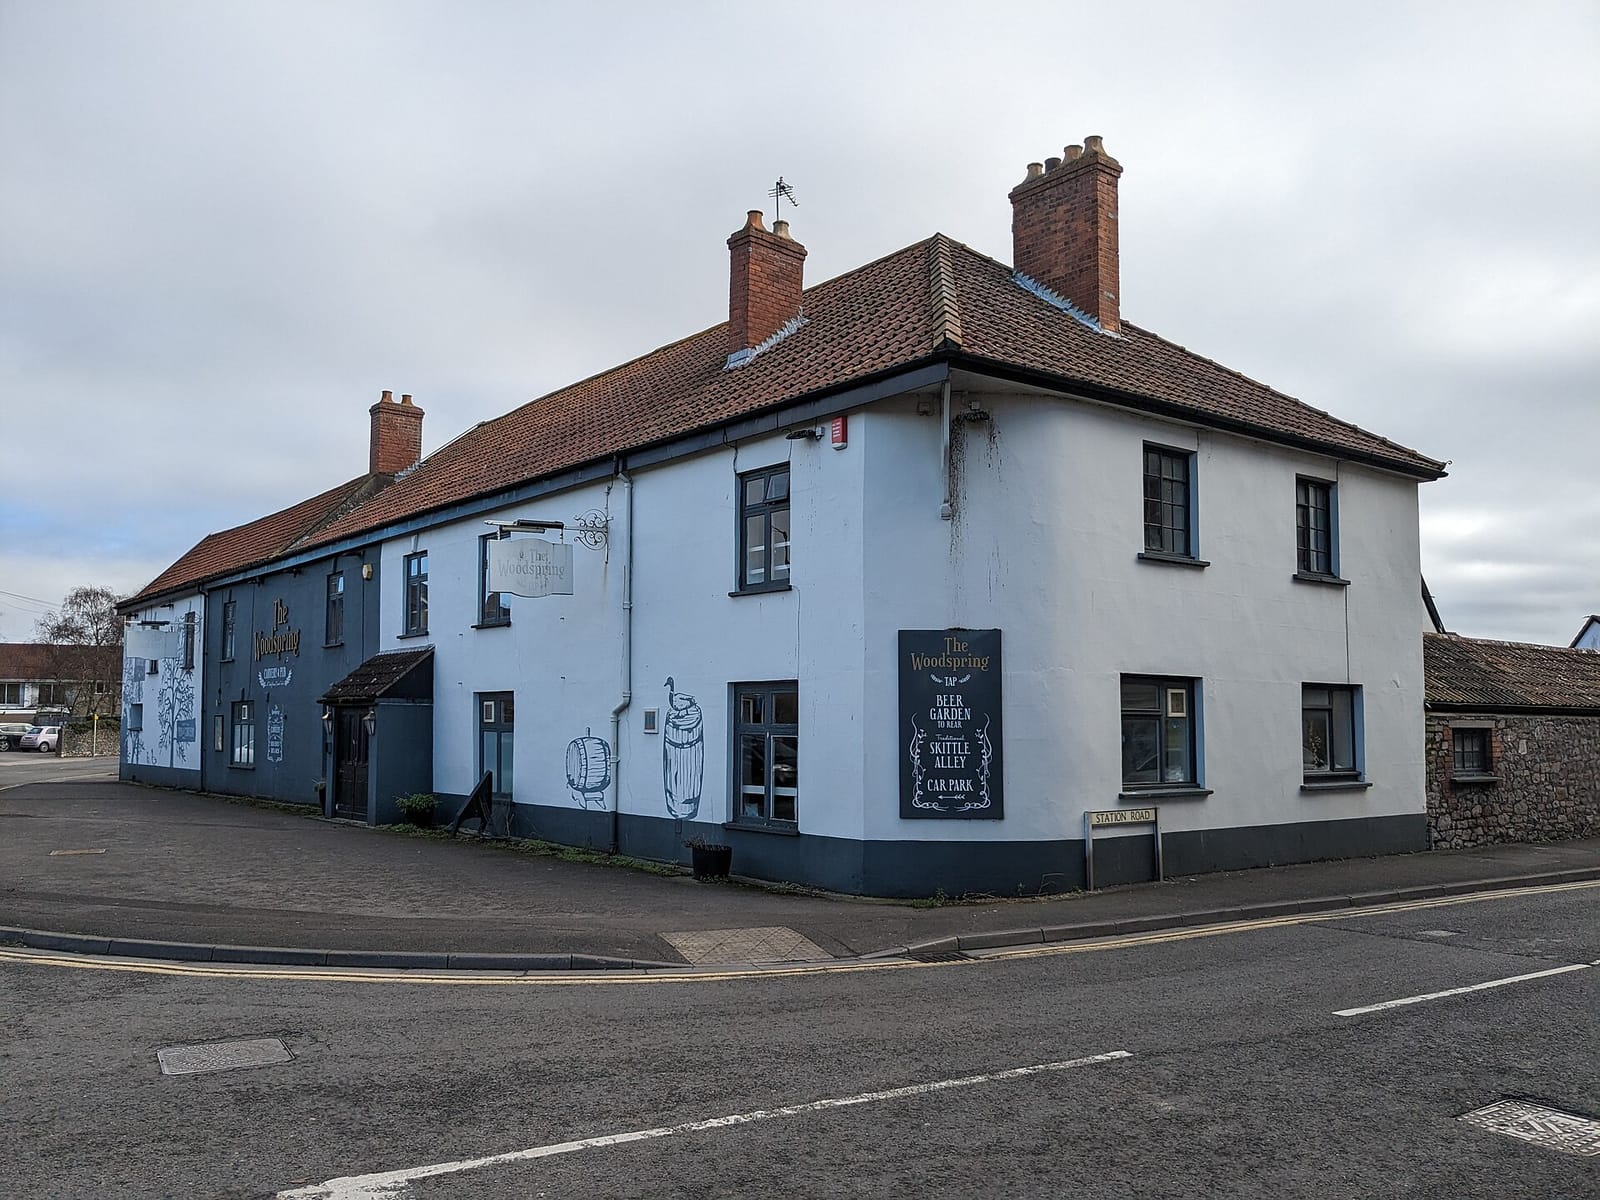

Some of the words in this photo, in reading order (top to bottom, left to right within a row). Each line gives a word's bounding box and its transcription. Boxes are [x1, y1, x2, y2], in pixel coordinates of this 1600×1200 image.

[273, 599, 288, 631] The
[254, 627, 300, 661] Woodspring
[944, 637, 968, 655] The
[911, 653, 990, 671] Woodspring
[944, 677, 957, 686] TAP
[936, 695, 964, 707] BEER
[930, 708, 971, 721] GARDEN
[930, 742, 971, 754] SKITTLE
[935, 756, 966, 769] ALLEY
[927, 779, 947, 792] CAR
[949, 779, 974, 792] PARK
[1096, 813, 1127, 823] STATION
[1131, 811, 1150, 820] ROAD
